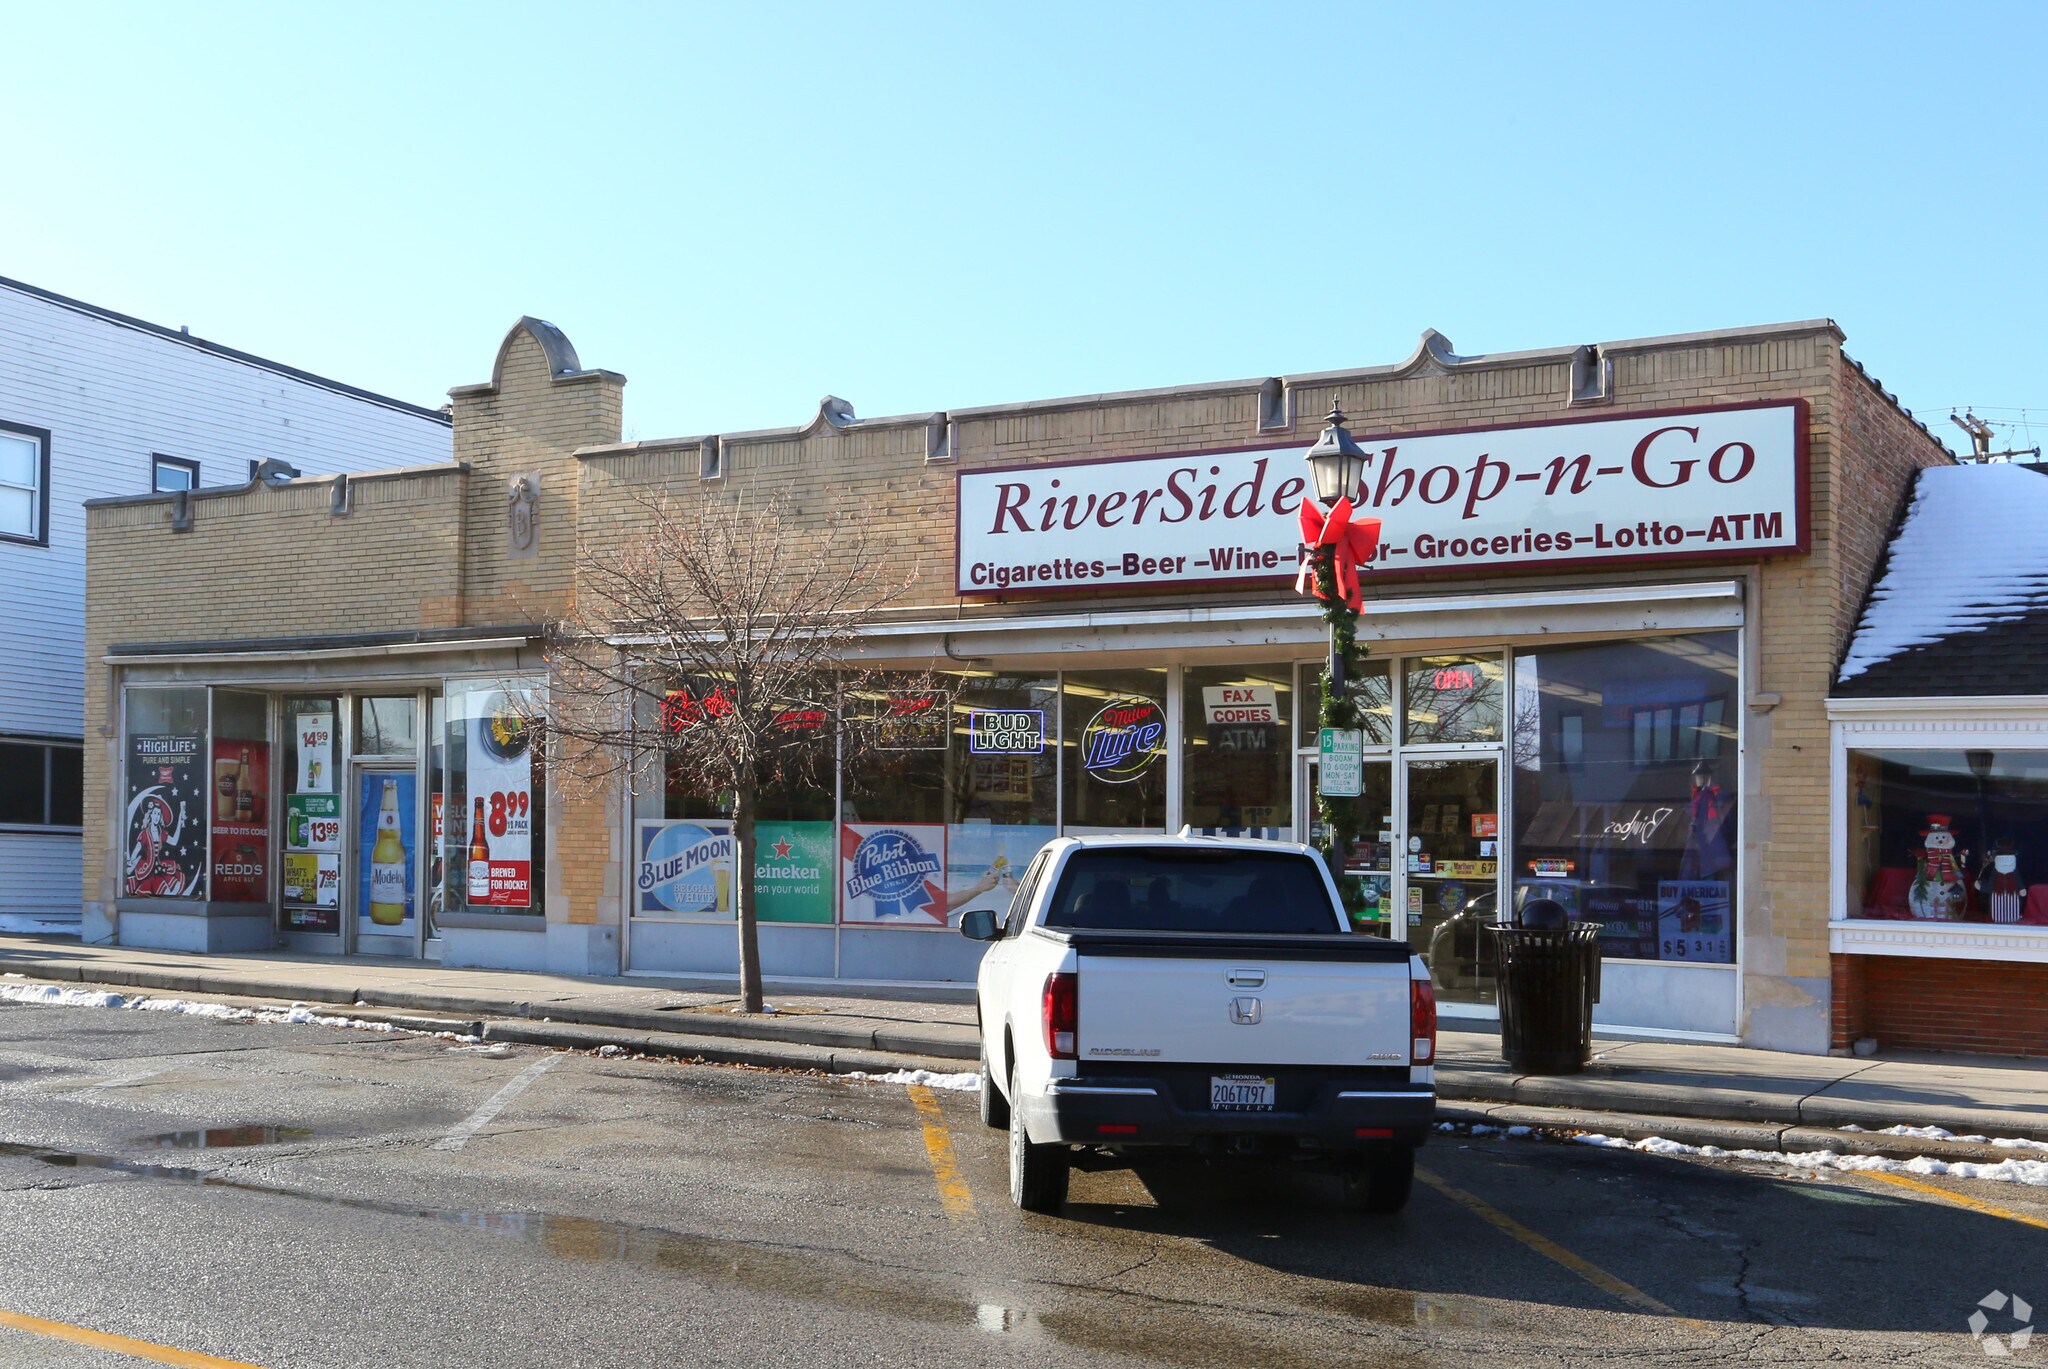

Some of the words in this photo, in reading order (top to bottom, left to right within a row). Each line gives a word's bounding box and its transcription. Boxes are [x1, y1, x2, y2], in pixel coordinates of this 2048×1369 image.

[1434, 670, 1474, 690] OPEN
[1223, 690, 1255, 702] FAX
[1104, 706, 1156, 727] Miller
[1213, 709, 1271, 723] COPIES
[984, 713, 1031, 732] BUD
[974, 731, 1040, 749] LIGHT
[1220, 729, 1267, 750] ATM
[1322, 735, 1332, 748] 15
[1340, 732, 1353, 741] MIN
[143, 740, 168, 752] HIGH
[170, 740, 191, 752] LIFE
[1333, 743, 1359, 752] PARKING
[142, 756, 157, 764] PURE
[158, 756, 170, 764] AND
[170, 756, 191, 764] SIMPLE
[1334, 763, 1359, 771] 6:00PM
[1325, 772, 1356, 780] MON-SAT
[515, 820, 529, 829] PACK
[229, 826, 239, 835] TO
[250, 828, 268, 836] CORE
[860, 840, 907, 869] Pabst
[286, 858, 293, 867] TO
[638, 860, 683, 889] BLUE
[686, 839, 731, 870] MOON
[375, 868, 402, 885] Modelo
[490, 867, 516, 878] BREWED
[849, 873, 882, 897] Blue
[881, 859, 938, 881] Ribbon
[490, 880, 503, 890] FOR
[674, 884, 716, 894] BELGIAN
[771, 885, 792, 896] your
[794, 884, 820, 895] world
[674, 892, 716, 903] WHITE
[1661, 887, 1678, 898] BUY
[1681, 887, 1727, 898] AMERICAN
[1589, 900, 1620, 911] Winston
[1605, 921, 1630, 933] KOOL
[1088, 1048, 1161, 1057] RIDGELINE
[1213, 1085, 1266, 1103] 2067797
